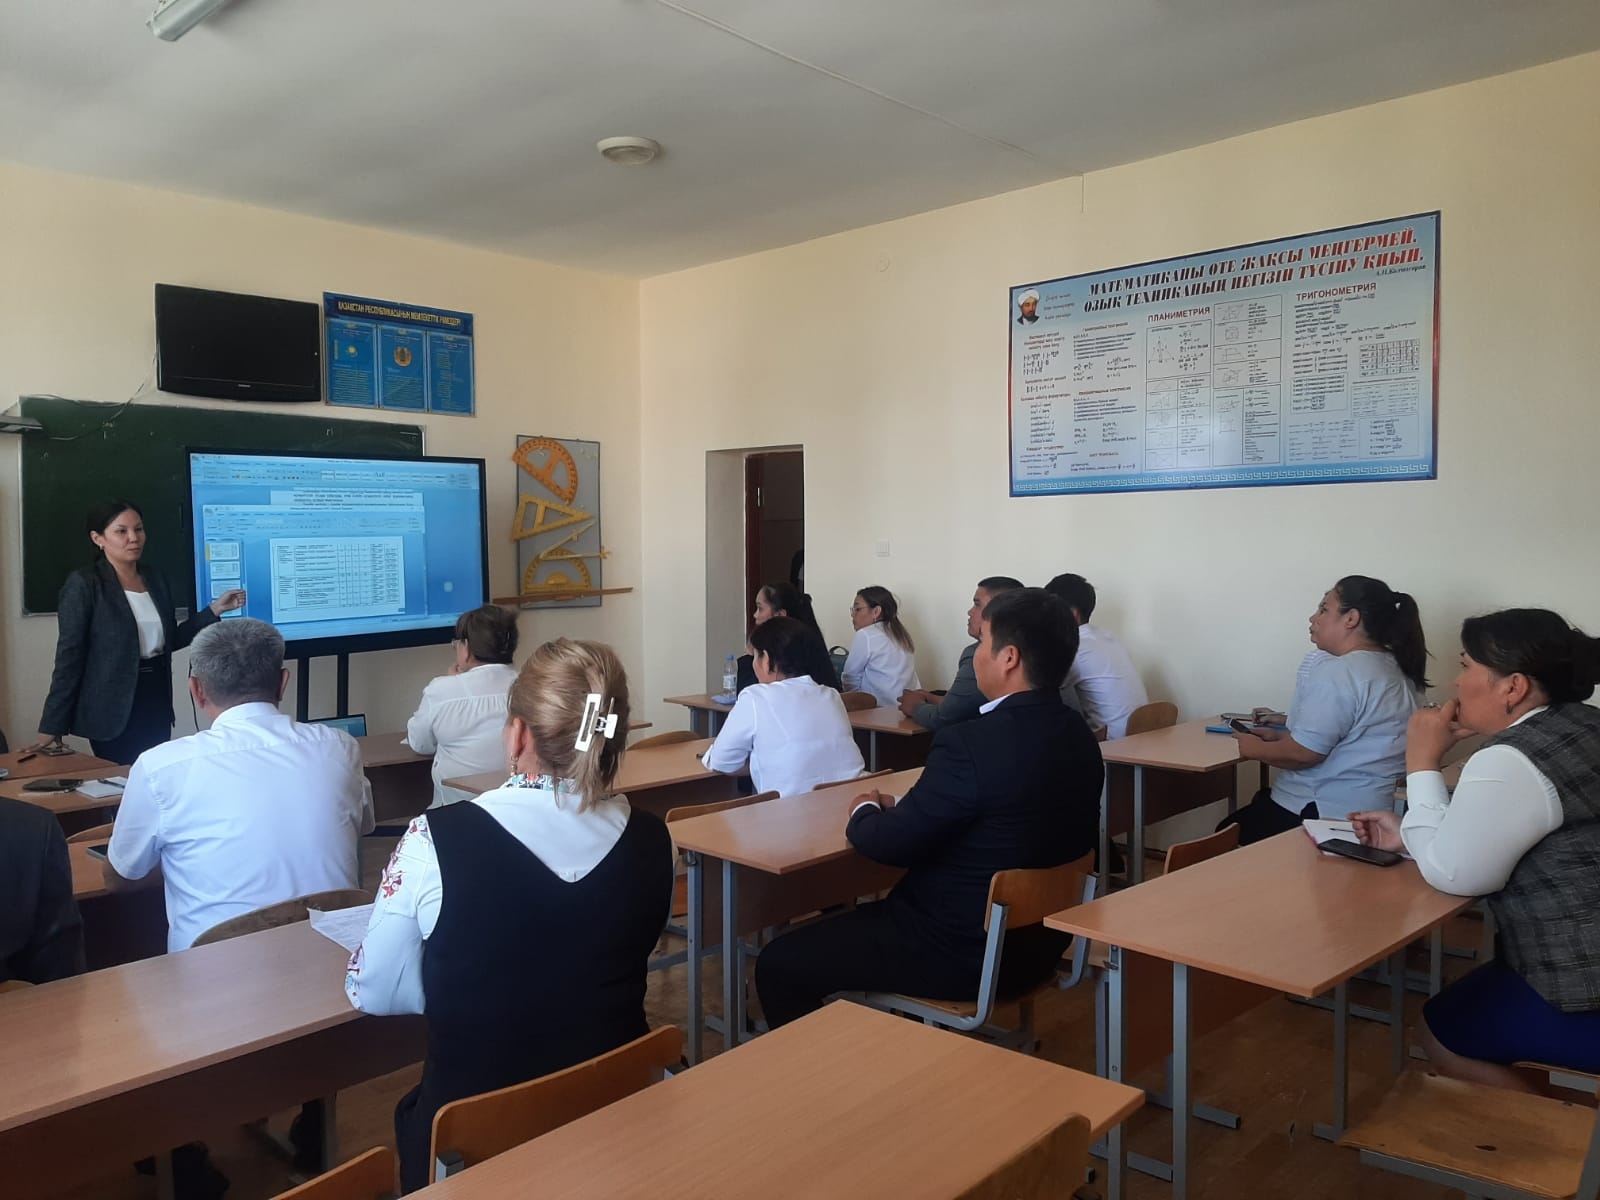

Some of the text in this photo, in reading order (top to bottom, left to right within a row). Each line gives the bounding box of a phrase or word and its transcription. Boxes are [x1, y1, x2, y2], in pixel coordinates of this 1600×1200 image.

[1089, 265, 1205, 297] МАТЕМАТИКАНЫ
[1296, 282, 1377, 301] ТРИГОНОМЕТРИЯ
[1147, 306, 1211, 323] ПЛАНИМЕТРИЯ
